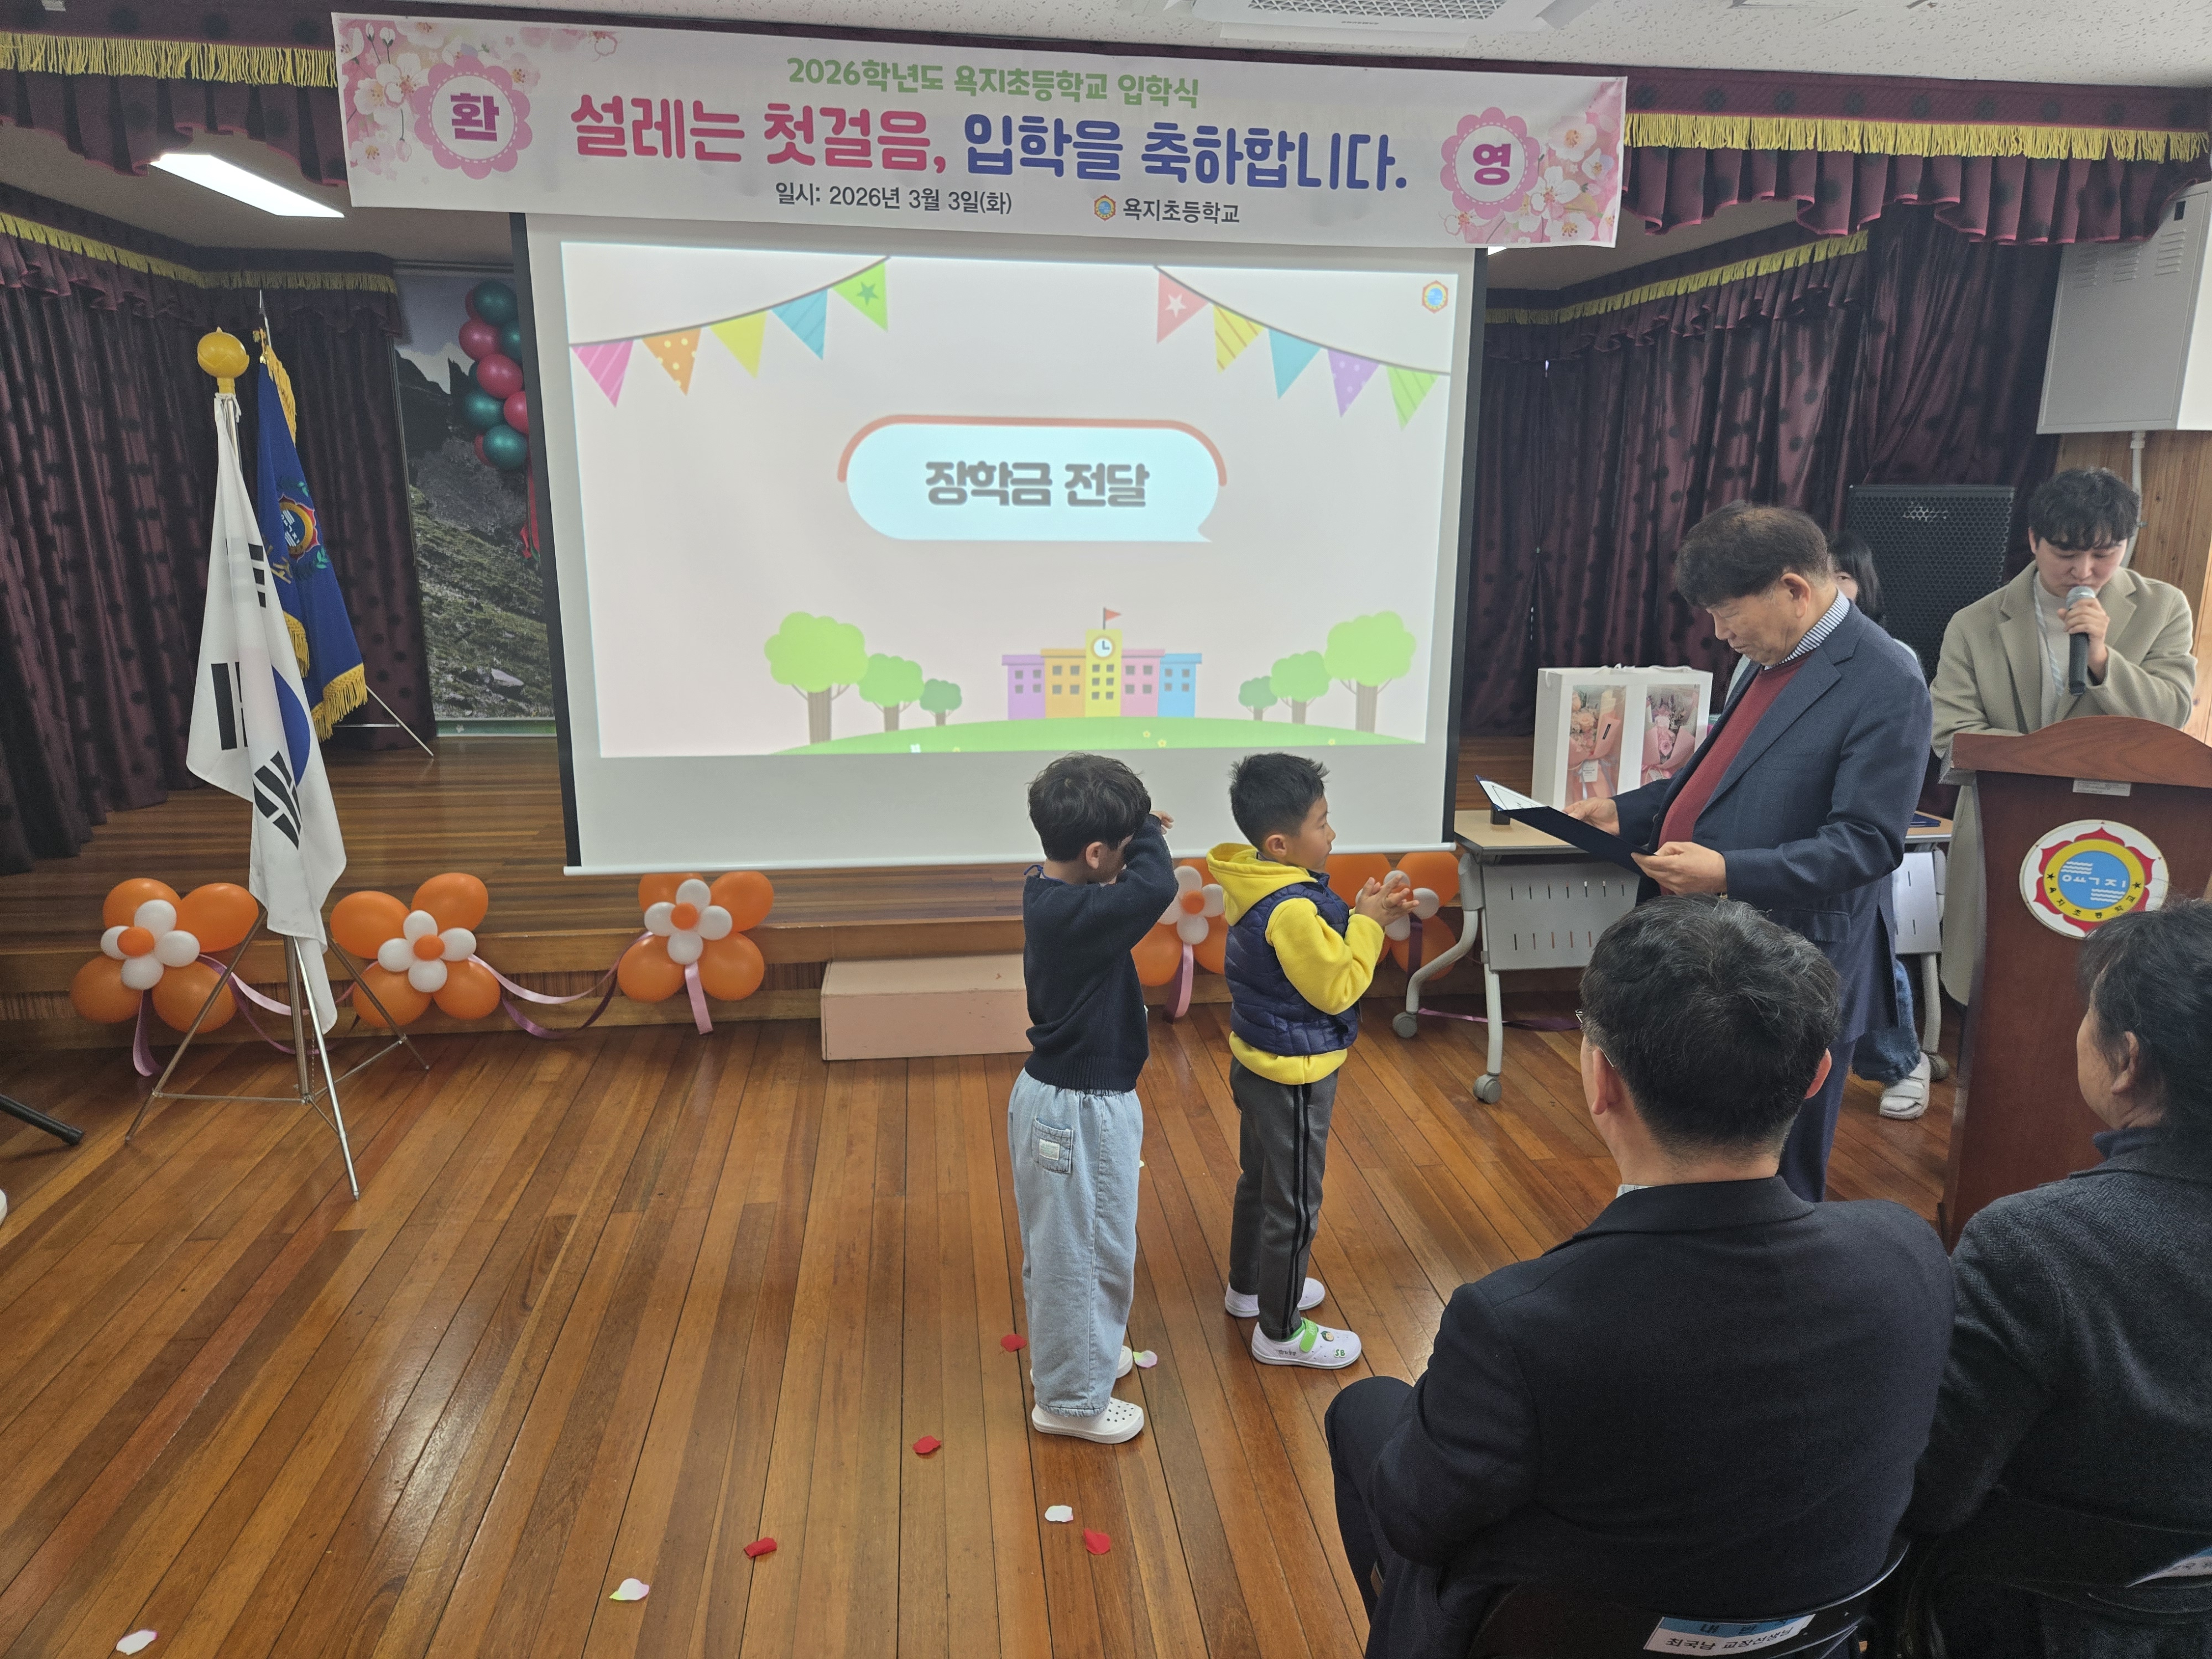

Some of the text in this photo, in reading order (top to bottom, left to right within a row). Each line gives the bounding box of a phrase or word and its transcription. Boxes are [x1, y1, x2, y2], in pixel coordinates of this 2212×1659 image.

[787, 58, 1198, 108] 2026학년도 욕지초등학교 입학식
[450, 92, 500, 142] 환
[571, 94, 1407, 191] 설레는 첫걸음, 입학을 축하합니다.
[1473, 143, 1511, 186] 영
[775, 181, 1012, 215] 일시: 2026년 3월 3일(화)
[1122, 198, 1240, 225] 욕지초등학교
[925, 461, 1150, 508] 장학금 전달
